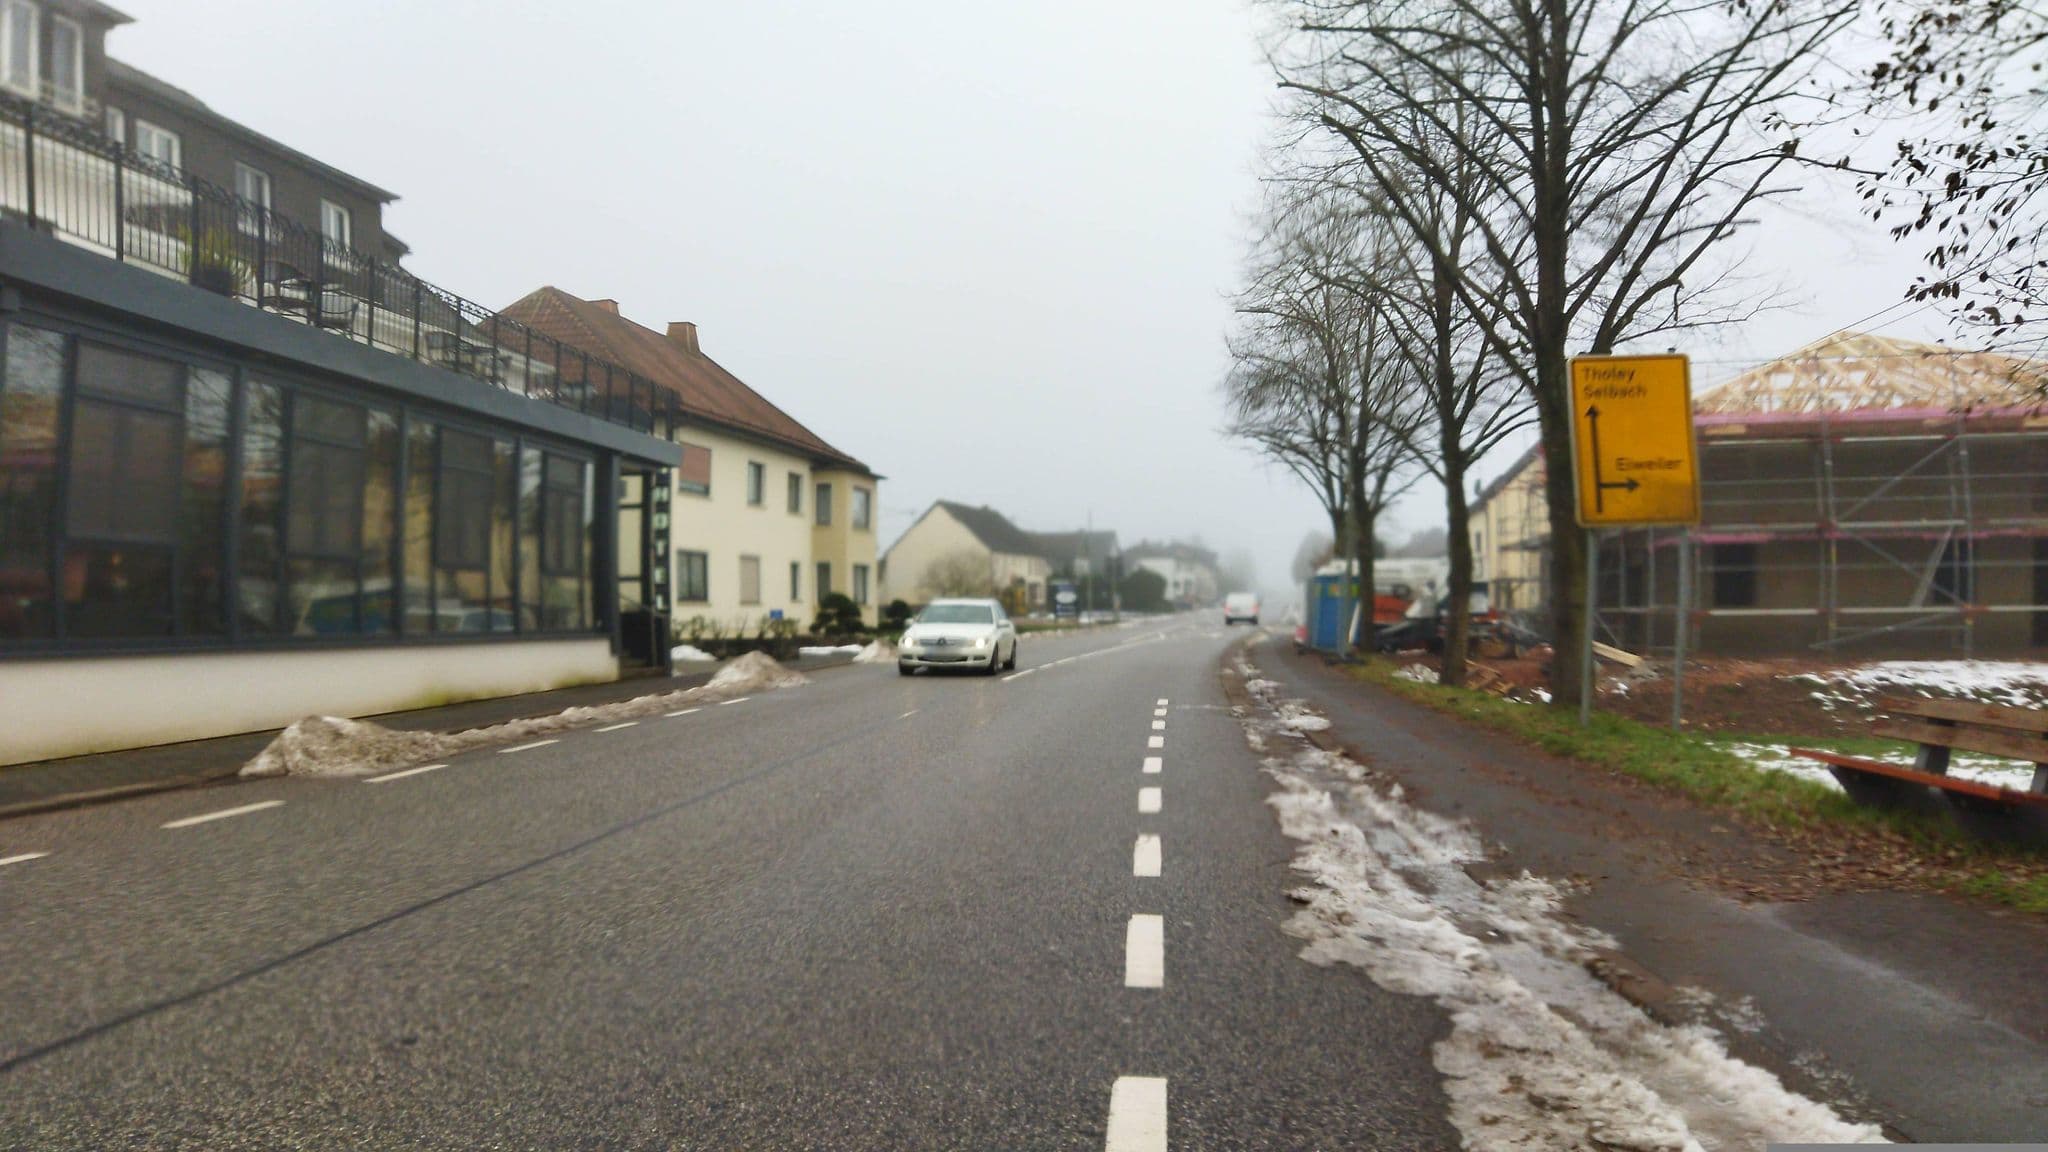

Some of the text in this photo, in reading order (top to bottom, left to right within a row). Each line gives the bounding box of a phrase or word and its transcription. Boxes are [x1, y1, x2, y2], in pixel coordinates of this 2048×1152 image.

[1583, 367, 1636, 382] Tholey
[1584, 384, 1647, 399] Selbach
[1616, 458, 1682, 471] Eiweiler
[654, 487, 669, 610] HOTEL
